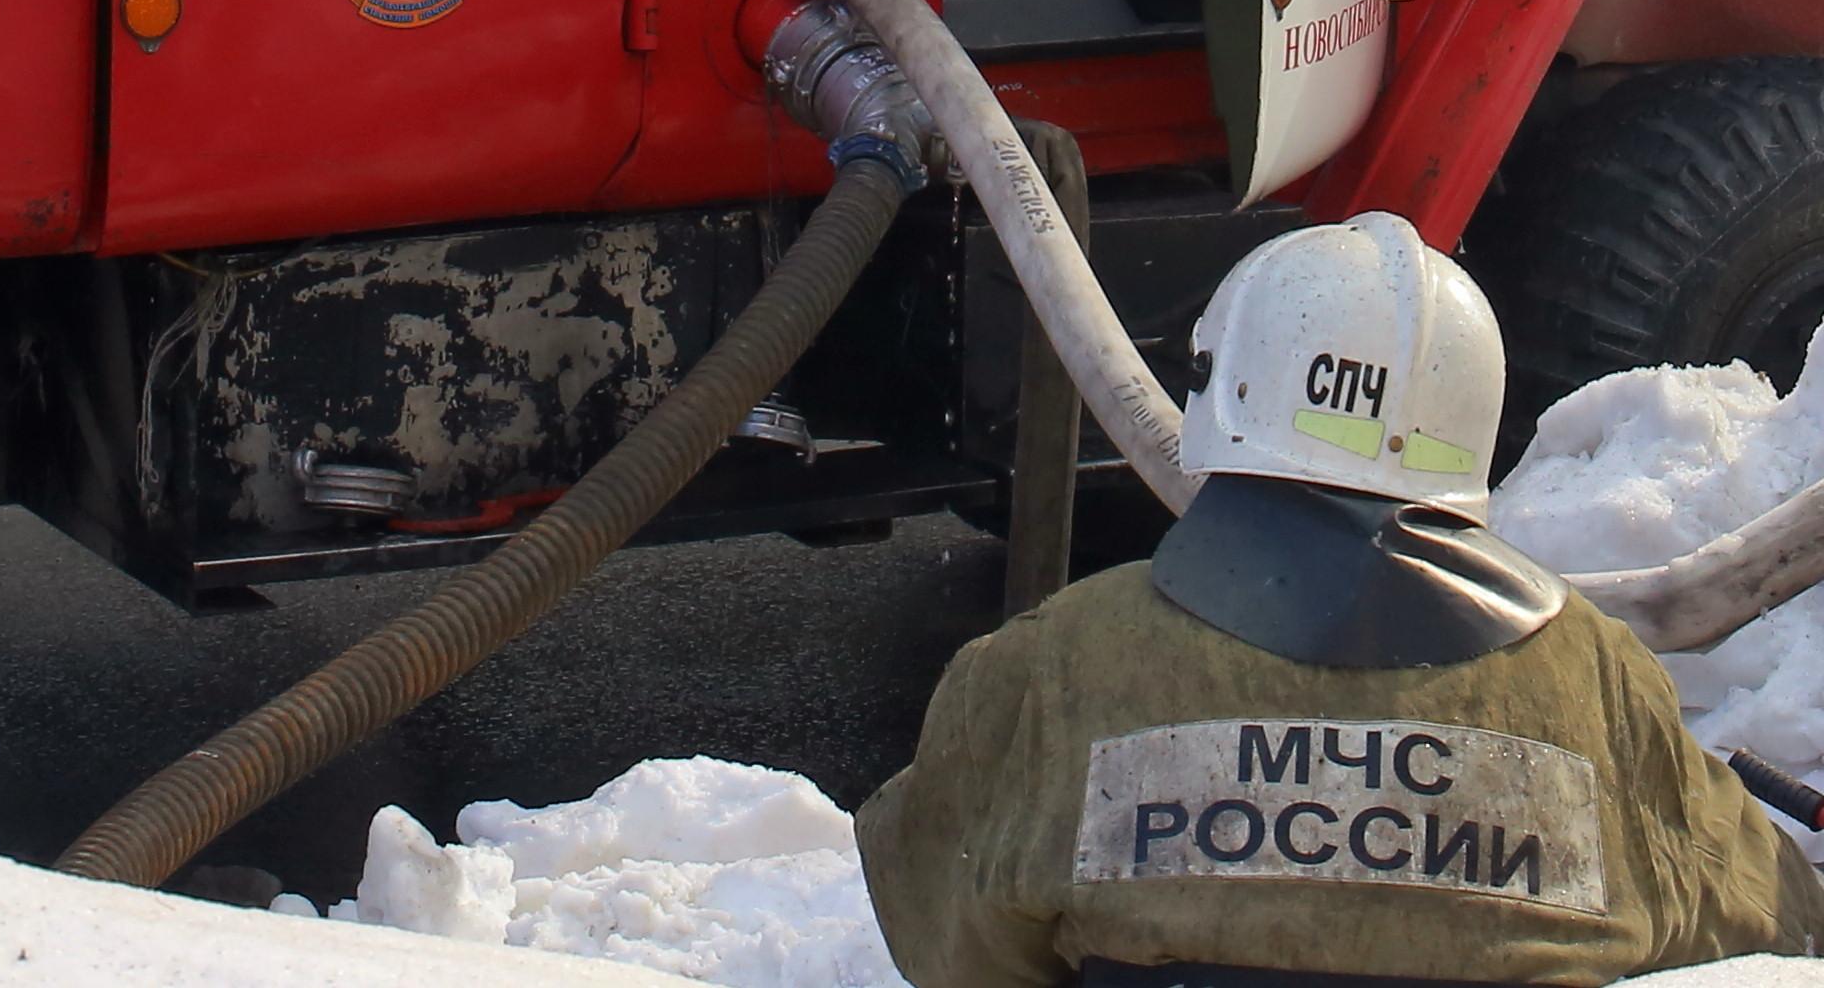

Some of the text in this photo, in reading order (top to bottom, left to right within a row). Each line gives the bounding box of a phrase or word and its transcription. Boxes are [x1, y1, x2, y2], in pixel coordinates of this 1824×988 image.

[1306, 353, 1388, 418] СПЧ
[1237, 724, 1453, 796] МЧС
[1134, 799, 1540, 895] РОССИИ
